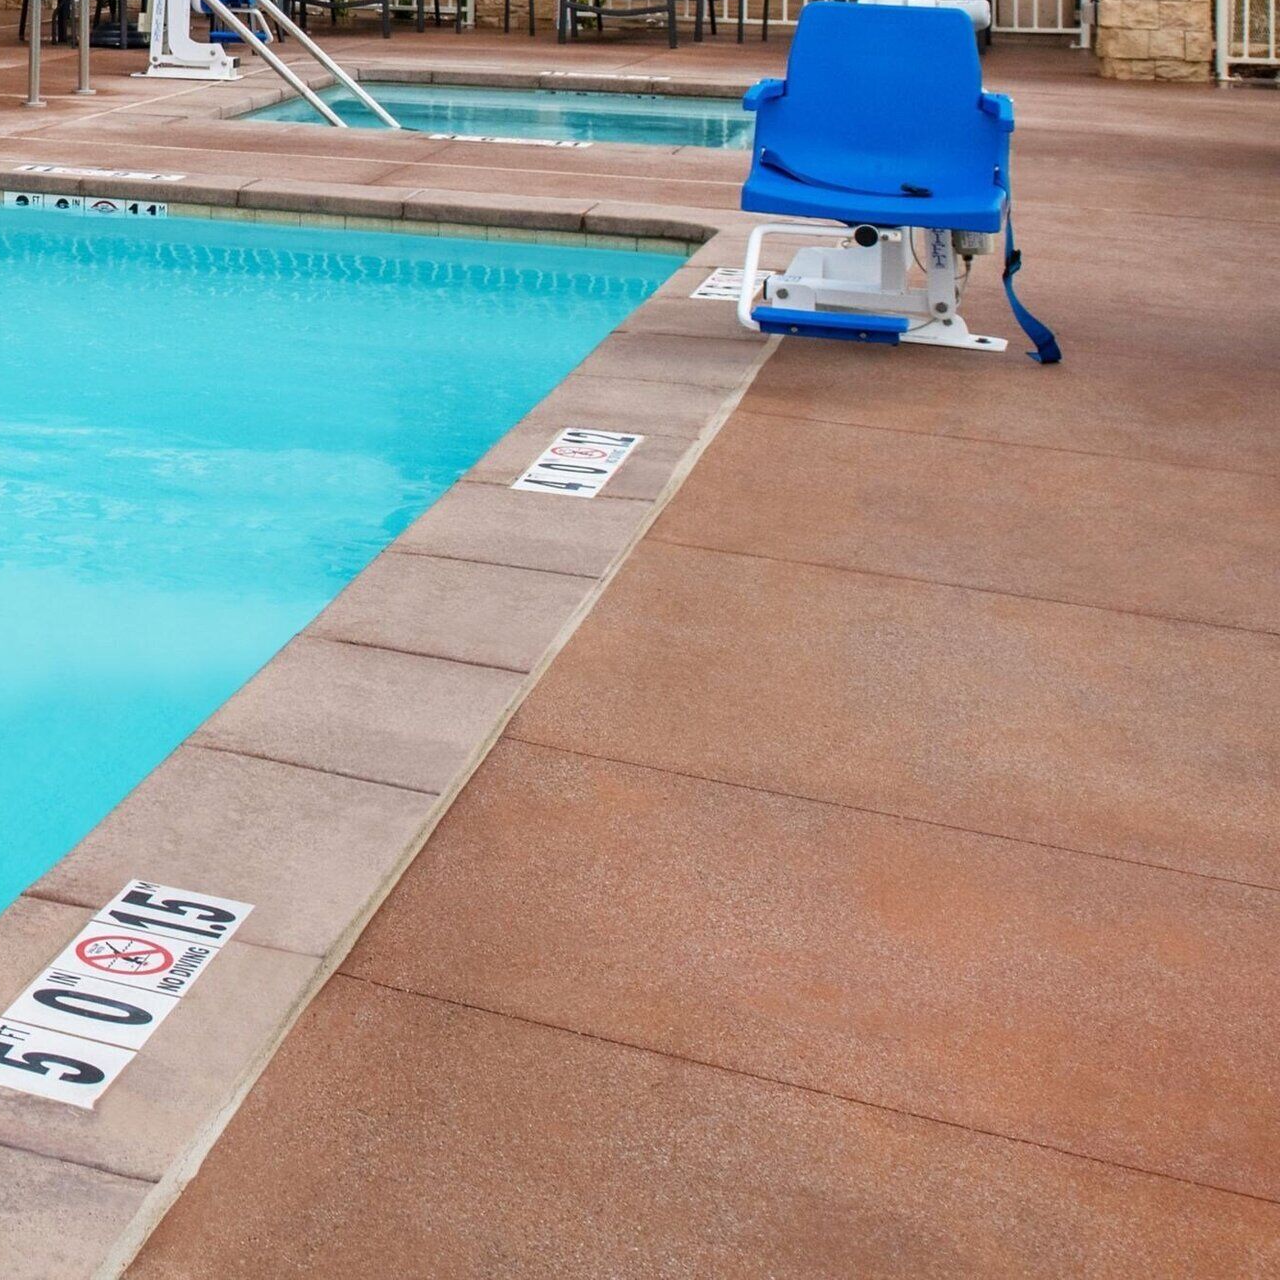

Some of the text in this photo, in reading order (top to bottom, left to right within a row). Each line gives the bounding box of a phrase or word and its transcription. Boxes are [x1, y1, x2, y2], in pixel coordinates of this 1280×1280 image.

[538, 463, 608, 474] 0
[523, 478, 596, 491] 4
[134, 881, 161, 893] M
[107, 889, 237, 940] 1.5
[156, 946, 211, 993] NO DIVING
[46, 971, 82, 987] IN
[32, 988, 153, 1026] 0
